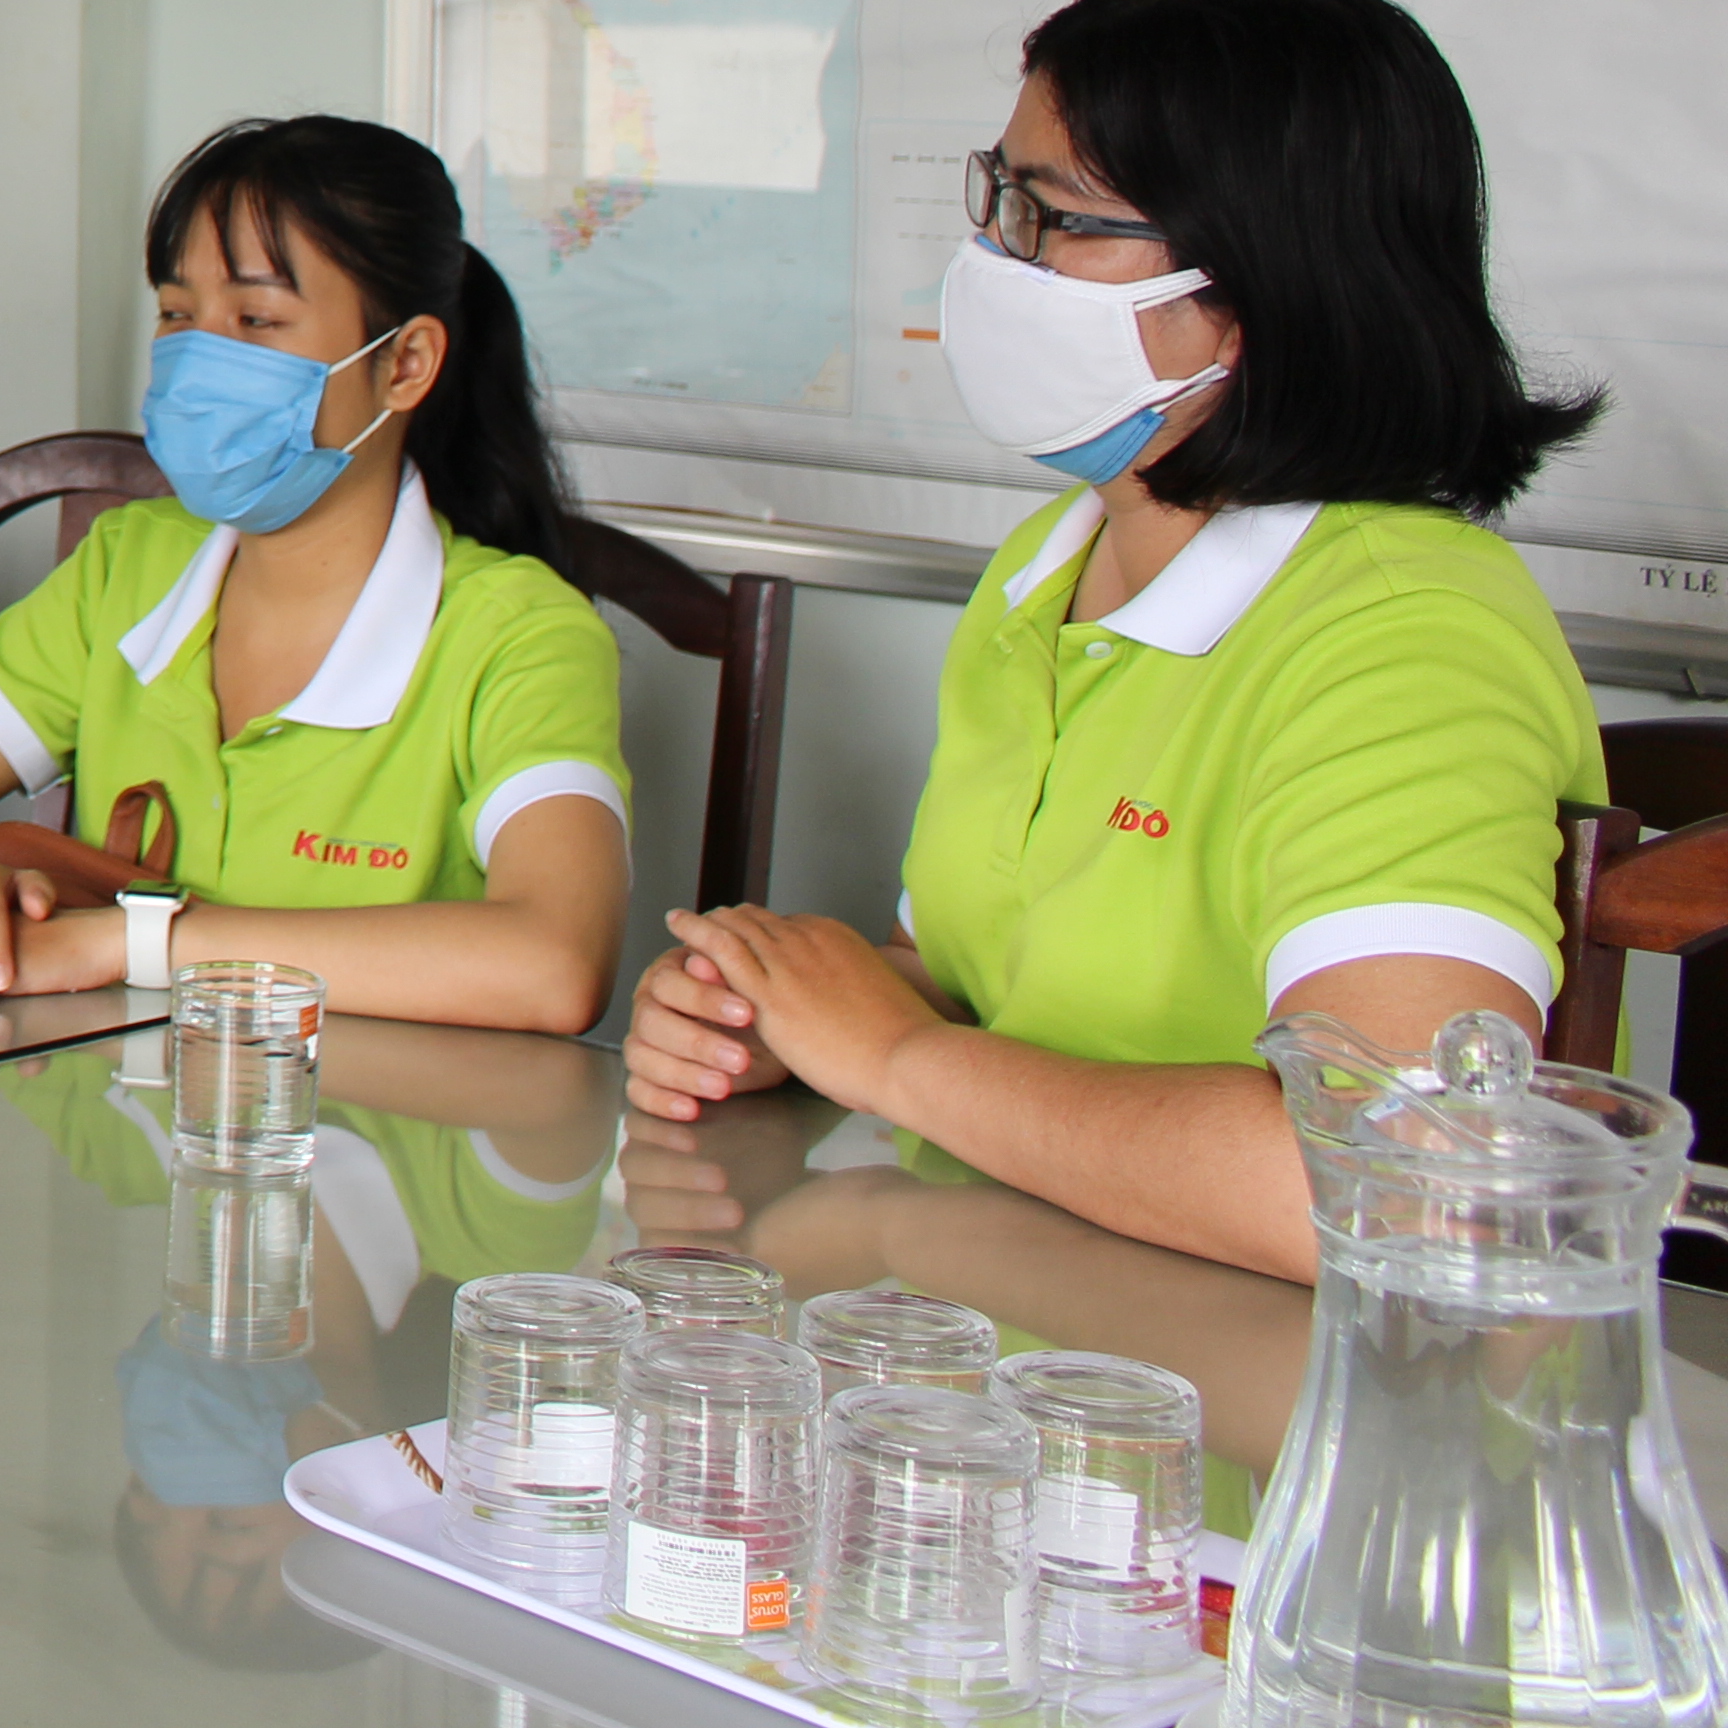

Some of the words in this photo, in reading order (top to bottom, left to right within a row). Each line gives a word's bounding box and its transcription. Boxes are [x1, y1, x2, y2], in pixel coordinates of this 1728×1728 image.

[1640, 562, 1676, 589] TỶ
[1683, 568, 1719, 599] LỆ
[292, 829, 359, 868] KIM
[369, 846, 410, 871] ĐÔ
[752, 1591, 784, 1603] GLASS
[752, 1604, 785, 1618] LOTUS
